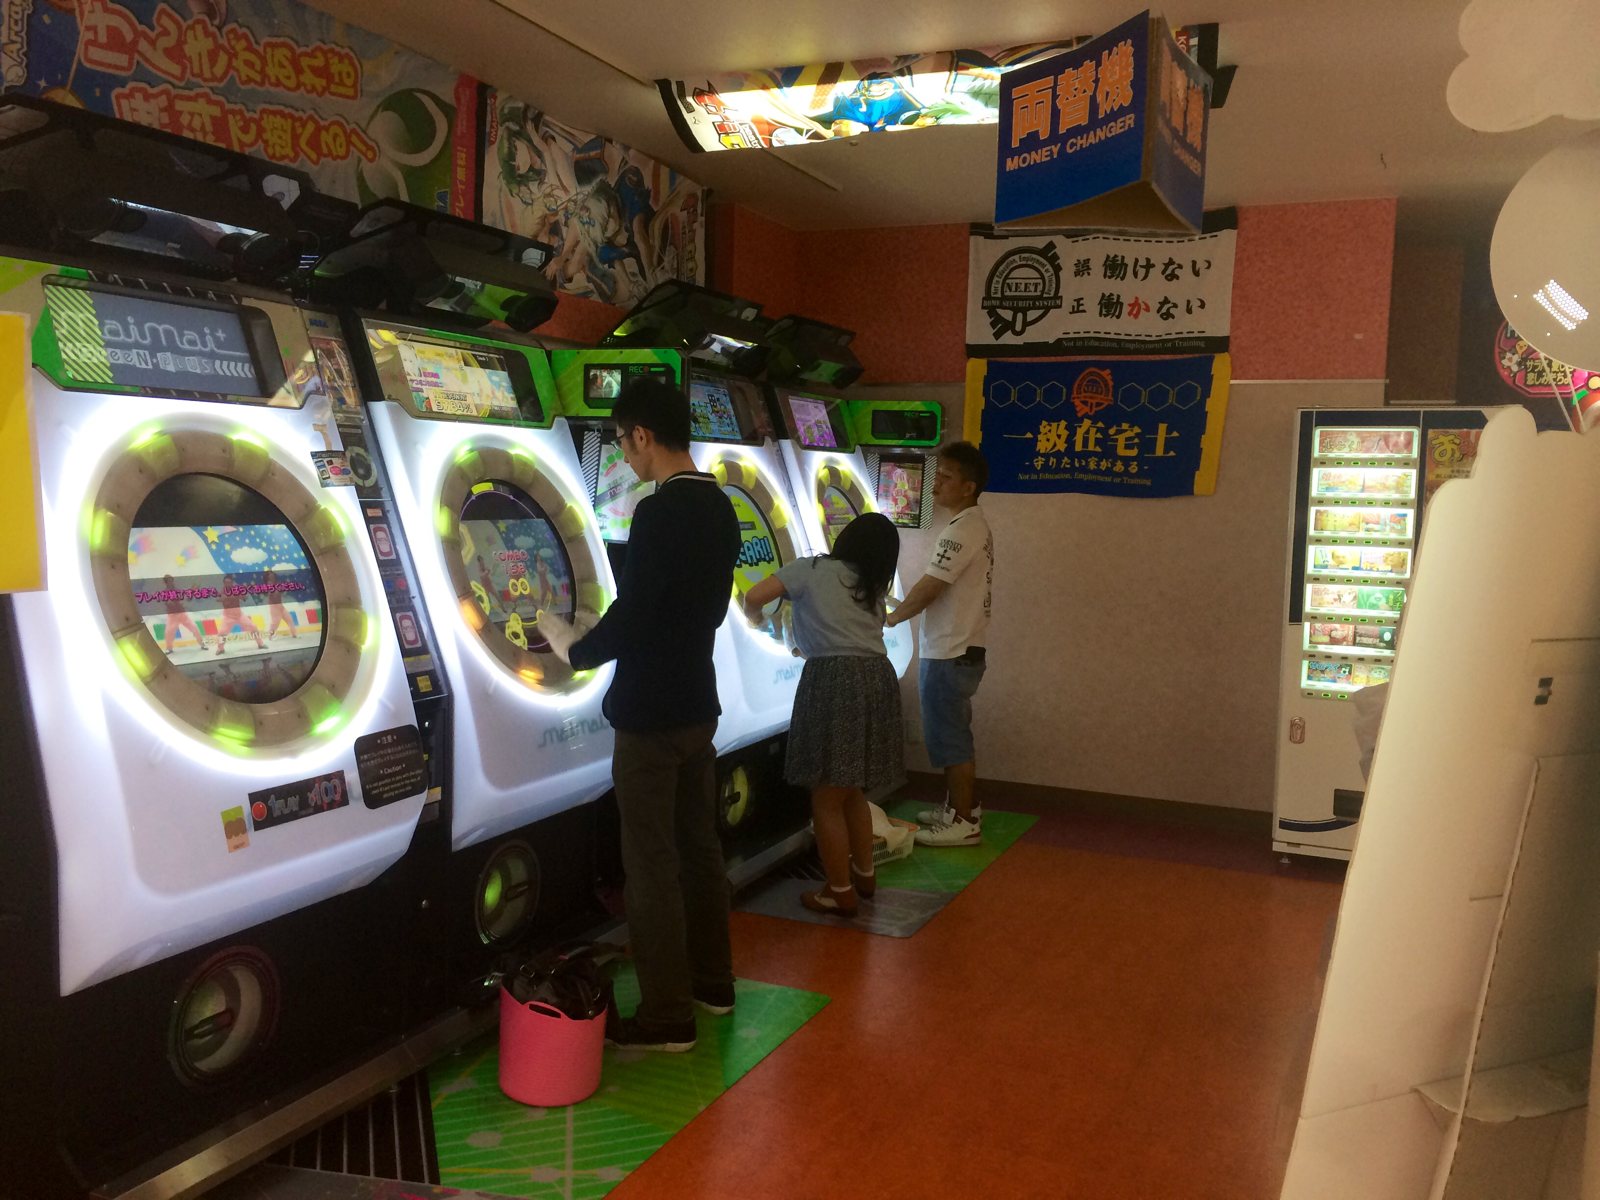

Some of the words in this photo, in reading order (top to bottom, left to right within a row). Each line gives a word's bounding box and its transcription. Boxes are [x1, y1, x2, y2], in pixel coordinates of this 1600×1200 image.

[1011, 39, 1134, 148] 両替機
[1005, 143, 1062, 172] MONEY
[1066, 114, 1135, 154] CHANGER
[1073, 258, 1092, 278] 誤
[1102, 253, 1212, 282] 働けない
[1069, 297, 1087, 315] 正
[1097, 292, 1206, 321] 働かない
[1003, 418, 1180, 458] 一級在宅士
